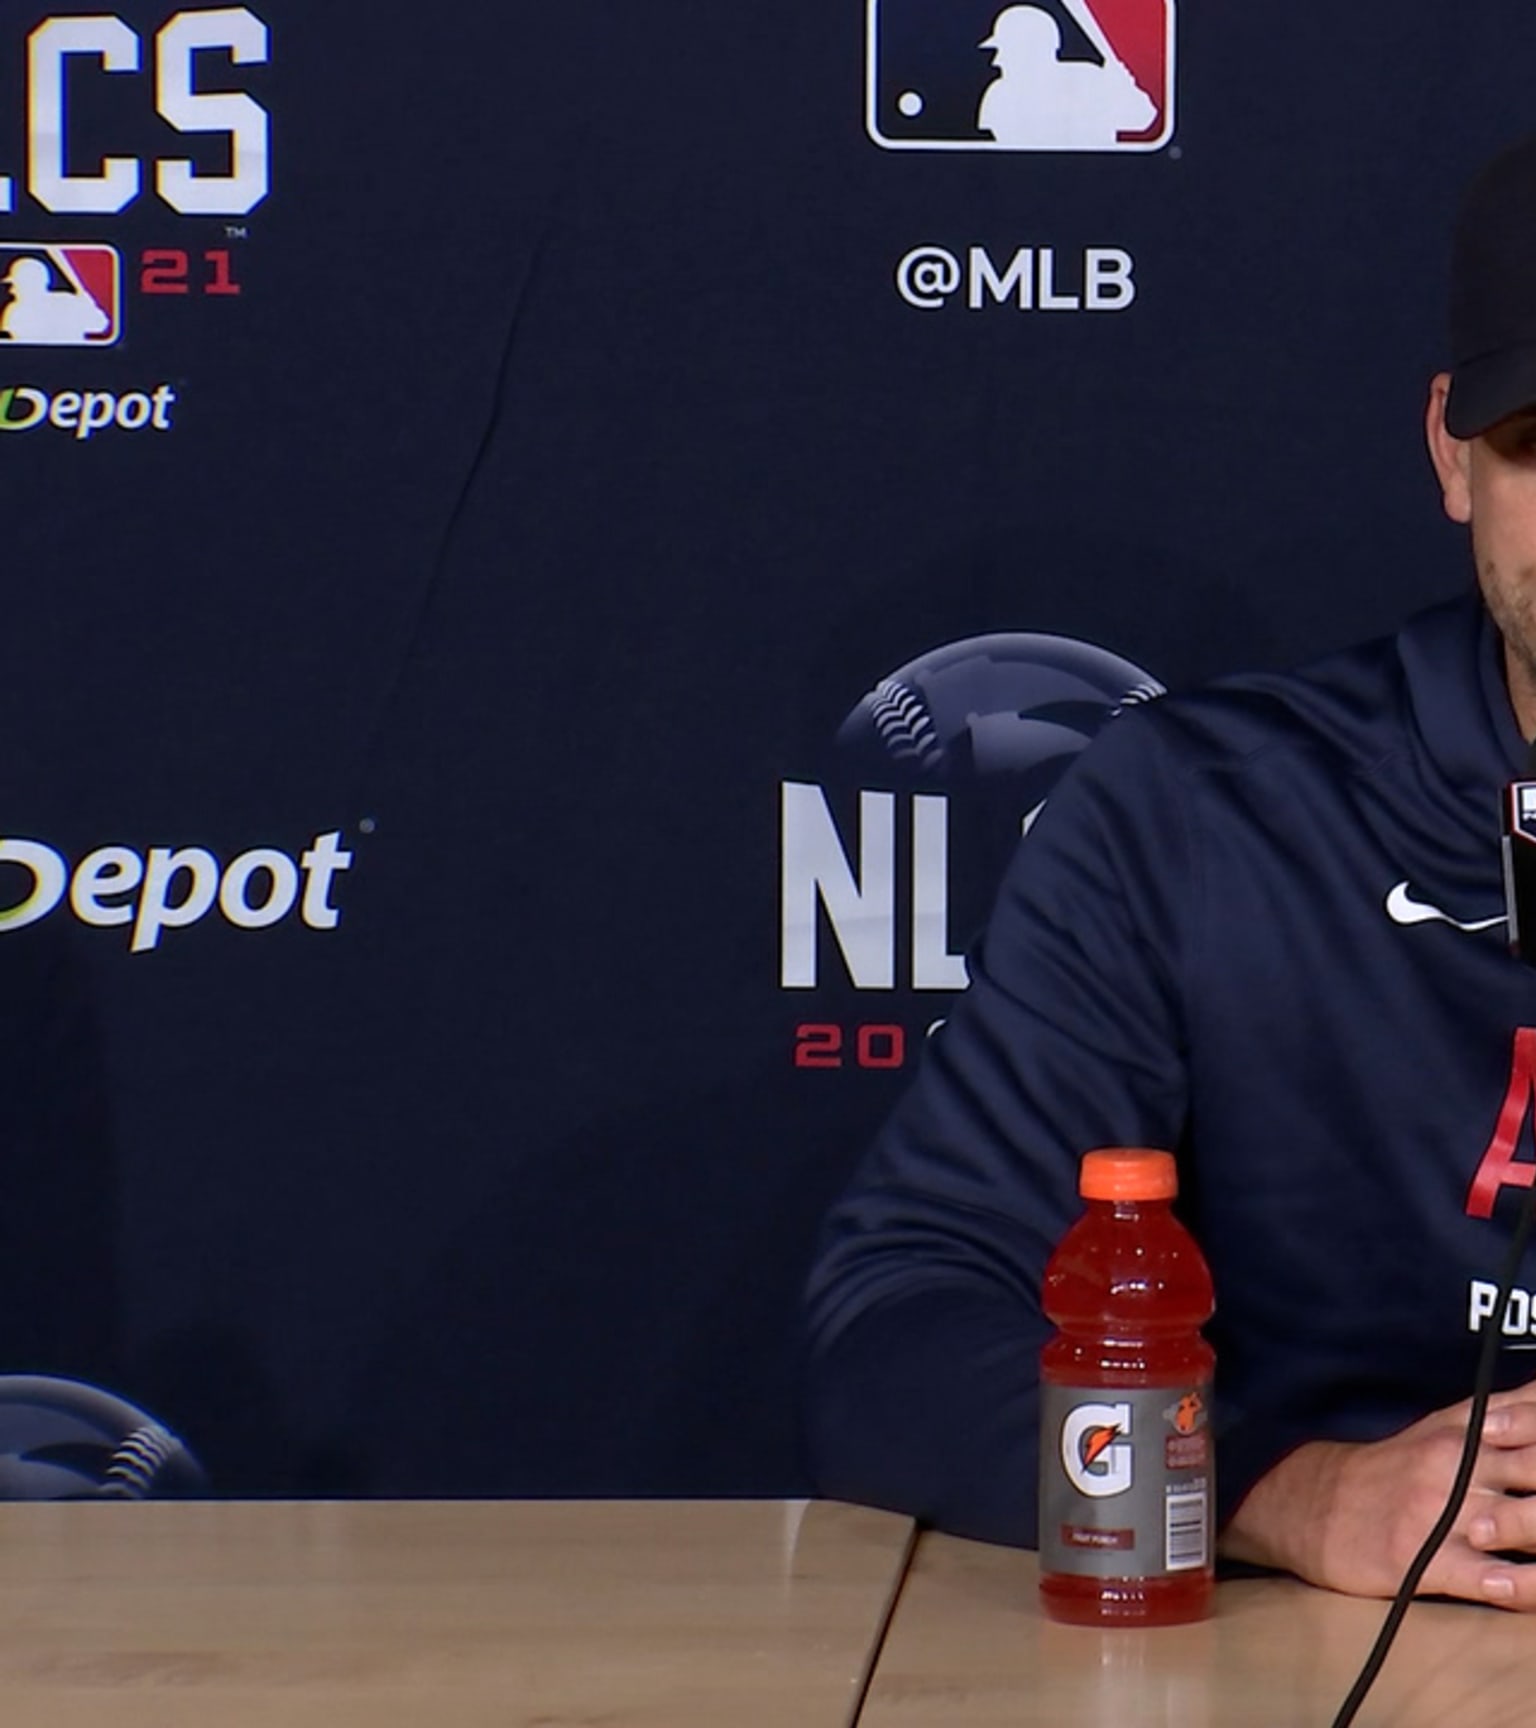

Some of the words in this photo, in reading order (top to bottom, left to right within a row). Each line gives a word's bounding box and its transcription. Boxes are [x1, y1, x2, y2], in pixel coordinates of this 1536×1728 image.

[0, 8, 269, 215] CS
[141, 250, 240, 294] 21
[897, 247, 1136, 311] @MLB
[781, 780, 1047, 989] NL
[794, 1024, 904, 1068] 20
[1061, 1403, 1133, 1498] G
